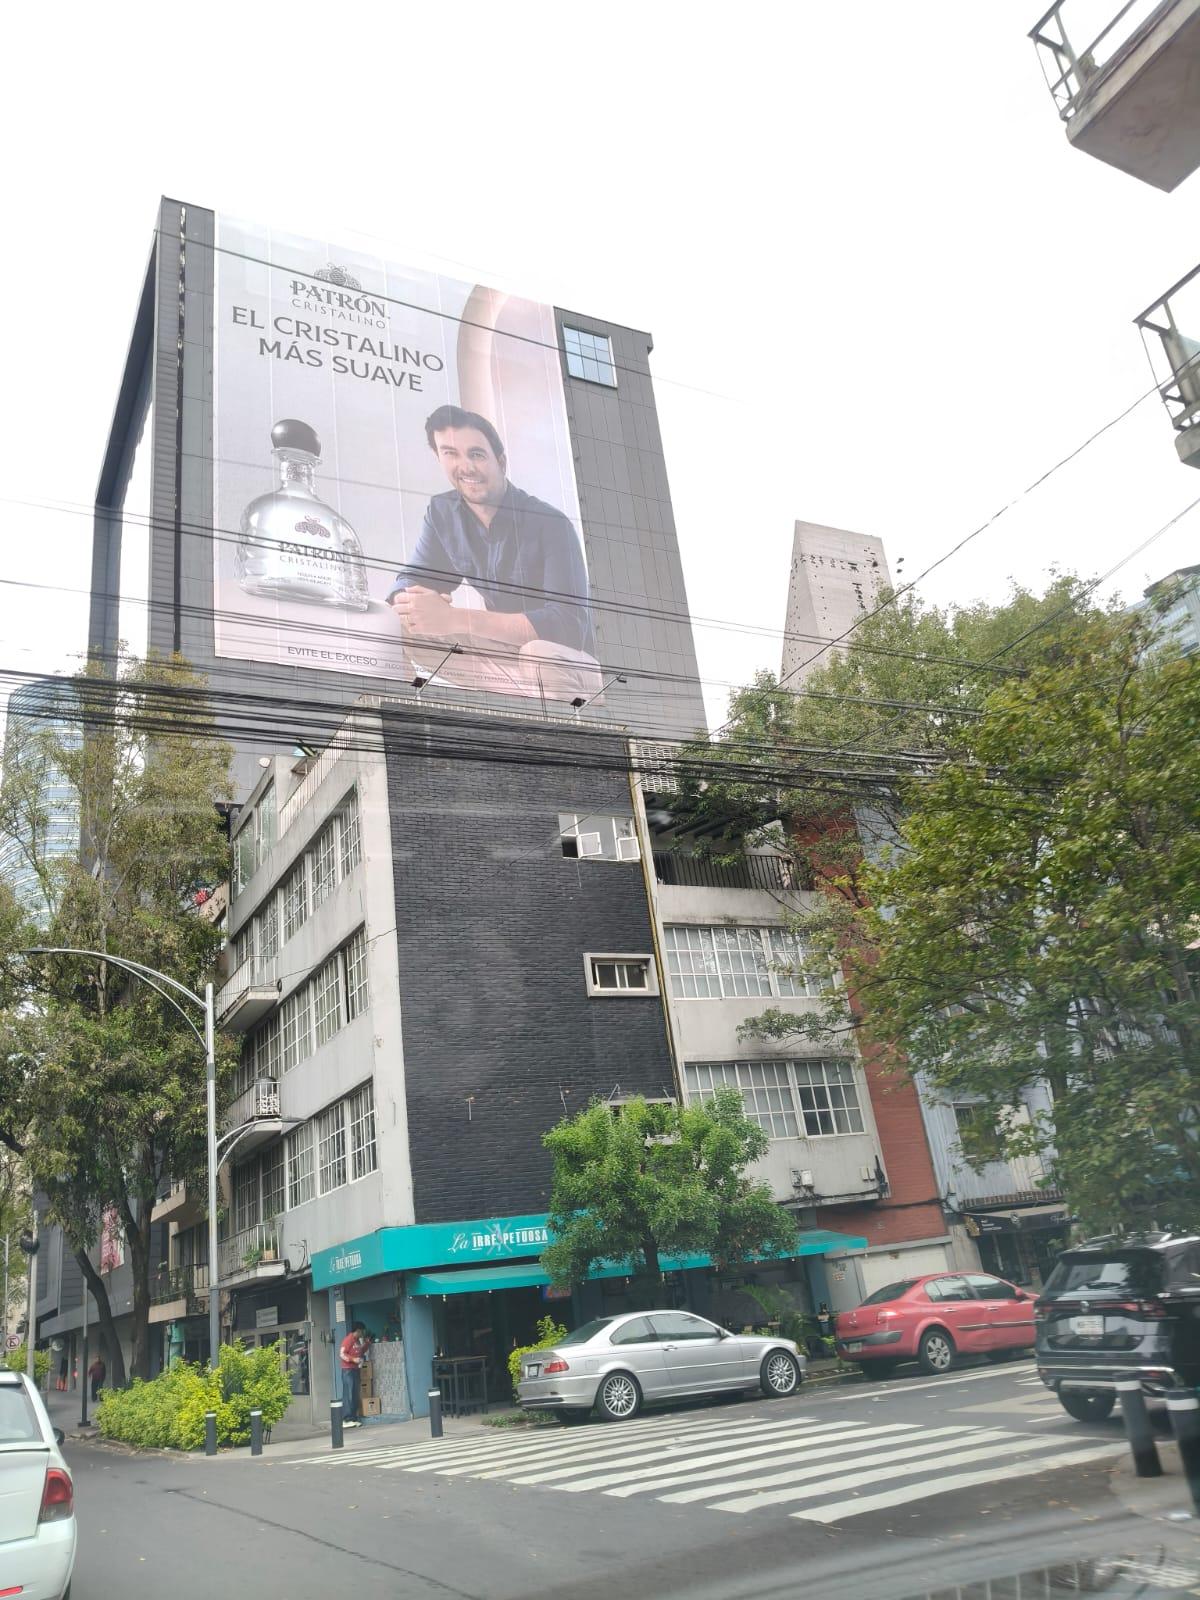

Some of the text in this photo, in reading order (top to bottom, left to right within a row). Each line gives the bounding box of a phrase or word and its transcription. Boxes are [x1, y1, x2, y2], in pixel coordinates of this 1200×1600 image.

[291, 299, 386, 329] CRISTALINO
[232, 306, 444, 372] EL CRISTALINO
[259, 337, 424, 392] MÁS SUAVE
[287, 646, 378, 666] EVITE EL EXCESO
[448, 1232, 469, 1253] La
